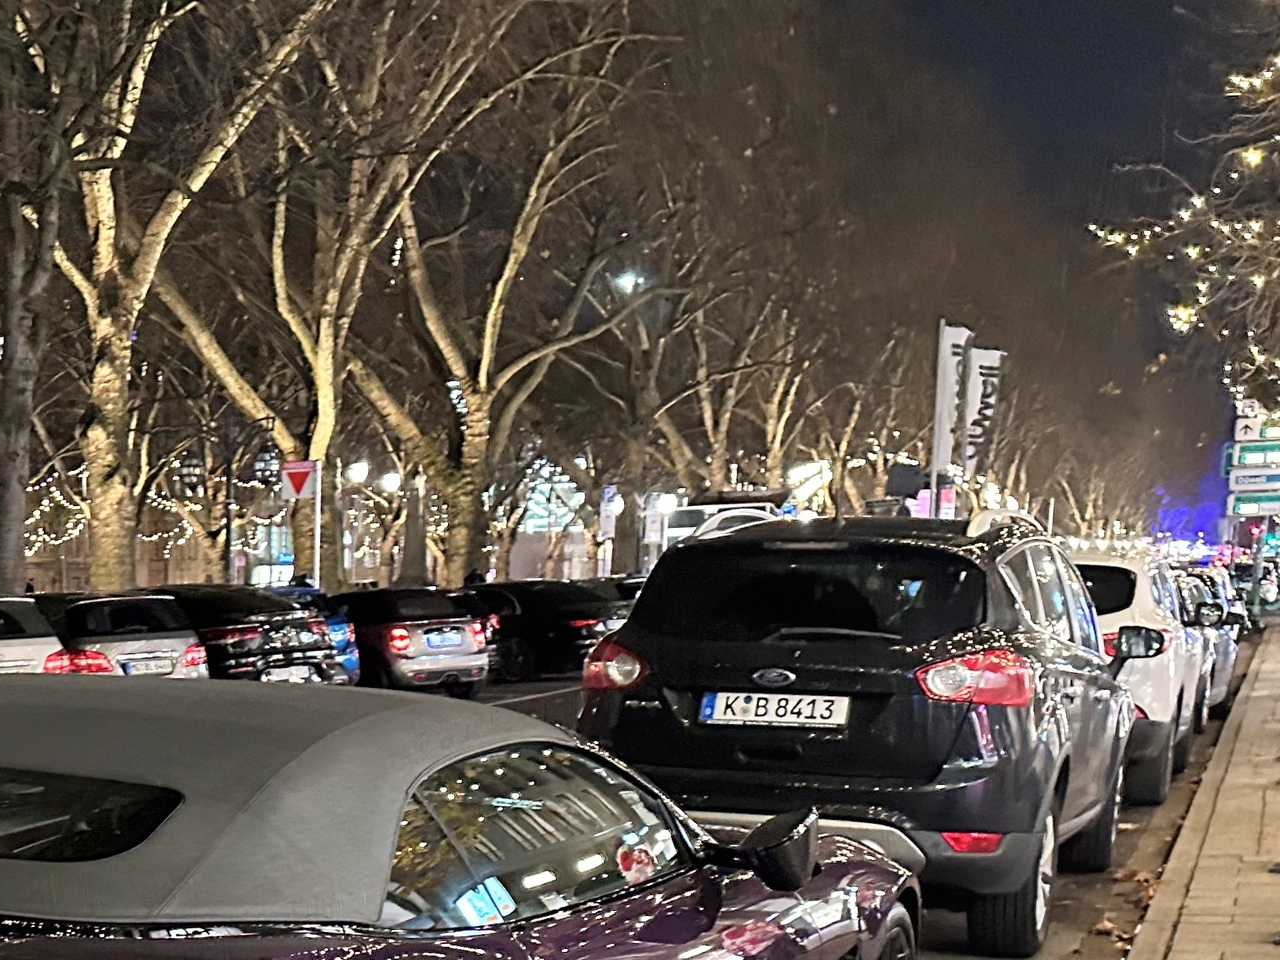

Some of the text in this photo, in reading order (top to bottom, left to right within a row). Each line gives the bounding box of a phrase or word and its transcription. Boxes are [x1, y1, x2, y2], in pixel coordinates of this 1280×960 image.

[723, 696, 835, 720] K B 8413
